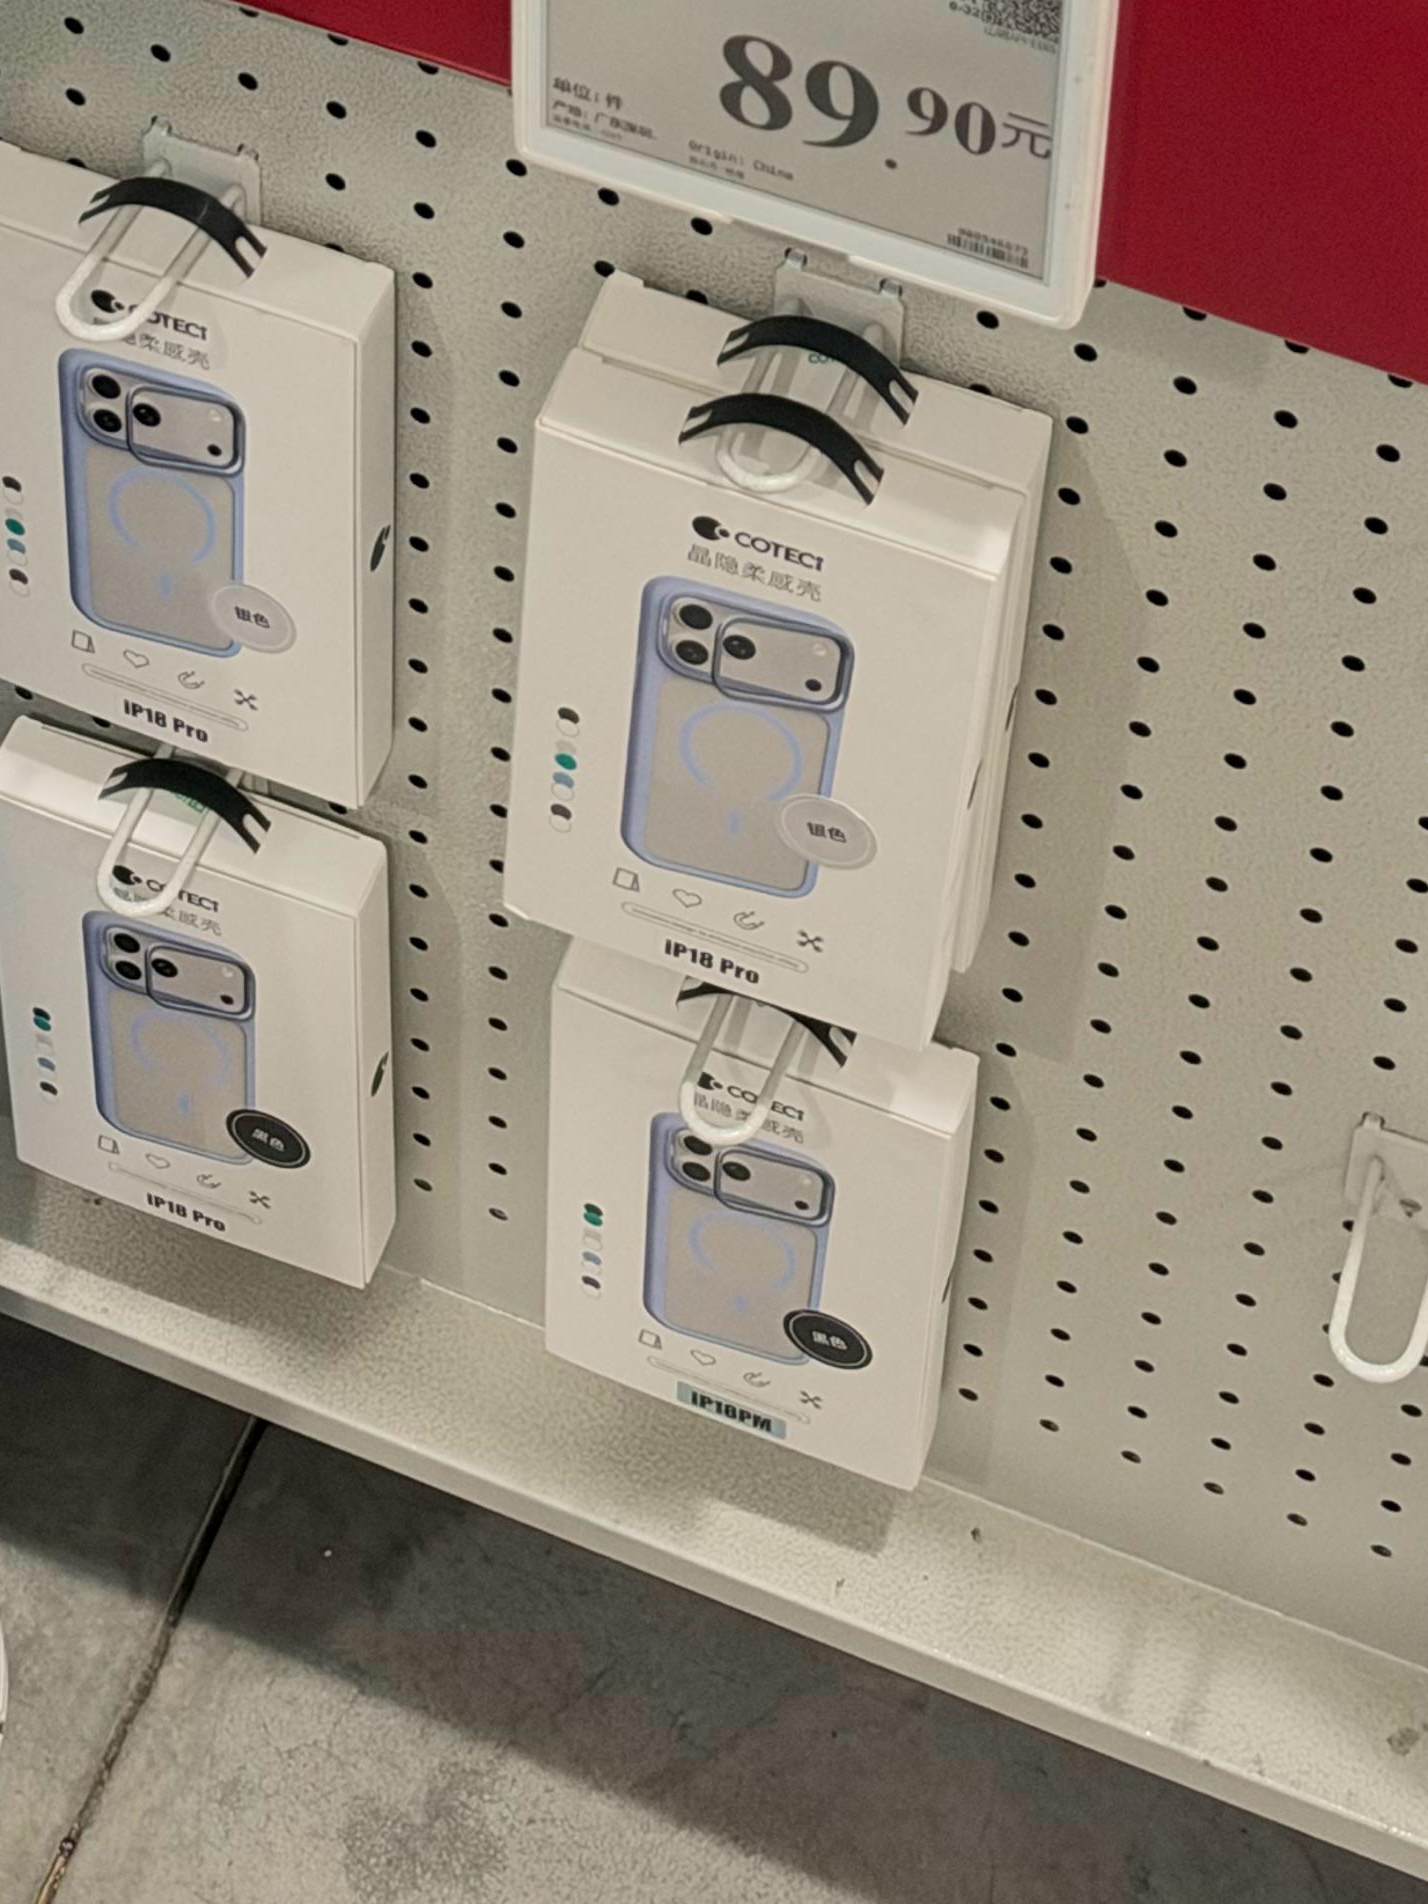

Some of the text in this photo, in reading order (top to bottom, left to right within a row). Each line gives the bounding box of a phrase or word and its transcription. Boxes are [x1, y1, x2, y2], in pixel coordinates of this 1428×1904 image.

[718, 33, 1054, 170] 89.90元
[753, 158, 795, 182] China
[687, 543, 822, 603] 晶隐柔感壳
[233, 603, 271, 630] 银色
[172, 716, 209, 743] Pro
[806, 819, 848, 847] 银色
[719, 957, 760, 984] Pro
[192, 1209, 226, 1232] Pro
